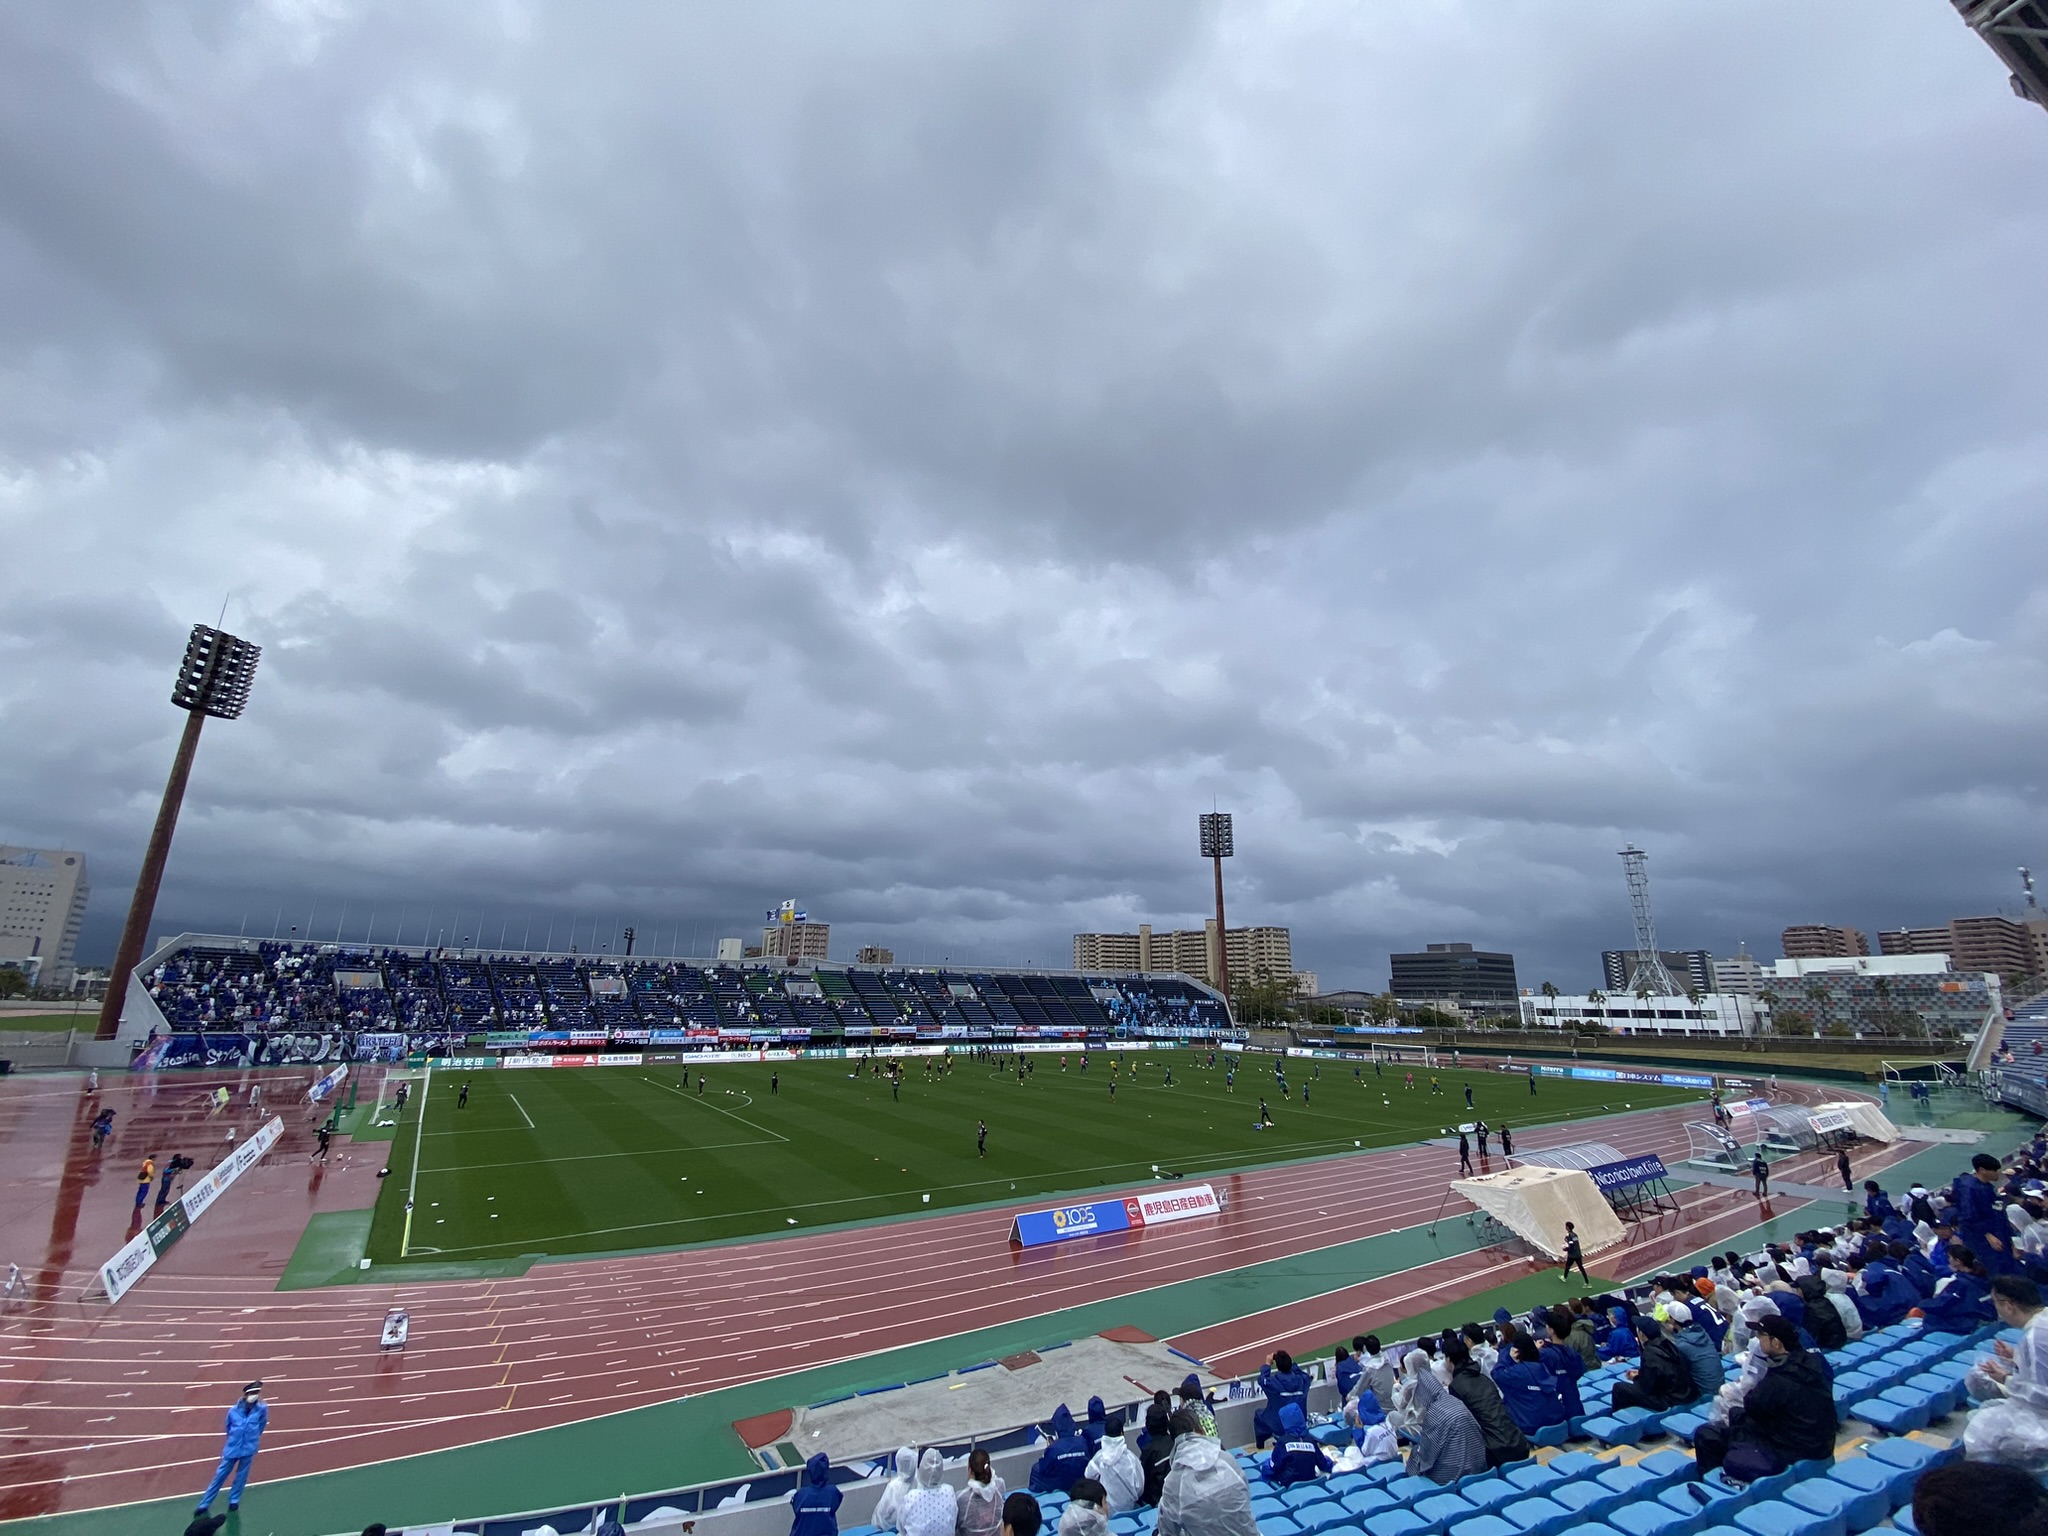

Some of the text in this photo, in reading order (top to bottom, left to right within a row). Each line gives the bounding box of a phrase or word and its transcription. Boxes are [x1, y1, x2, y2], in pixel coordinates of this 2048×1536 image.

[441, 1058, 485, 1066] 明治安田
[1682, 1077, 1711, 1085] akerun
[1143, 1193, 1215, 1216] 鹿児島日産自動車
